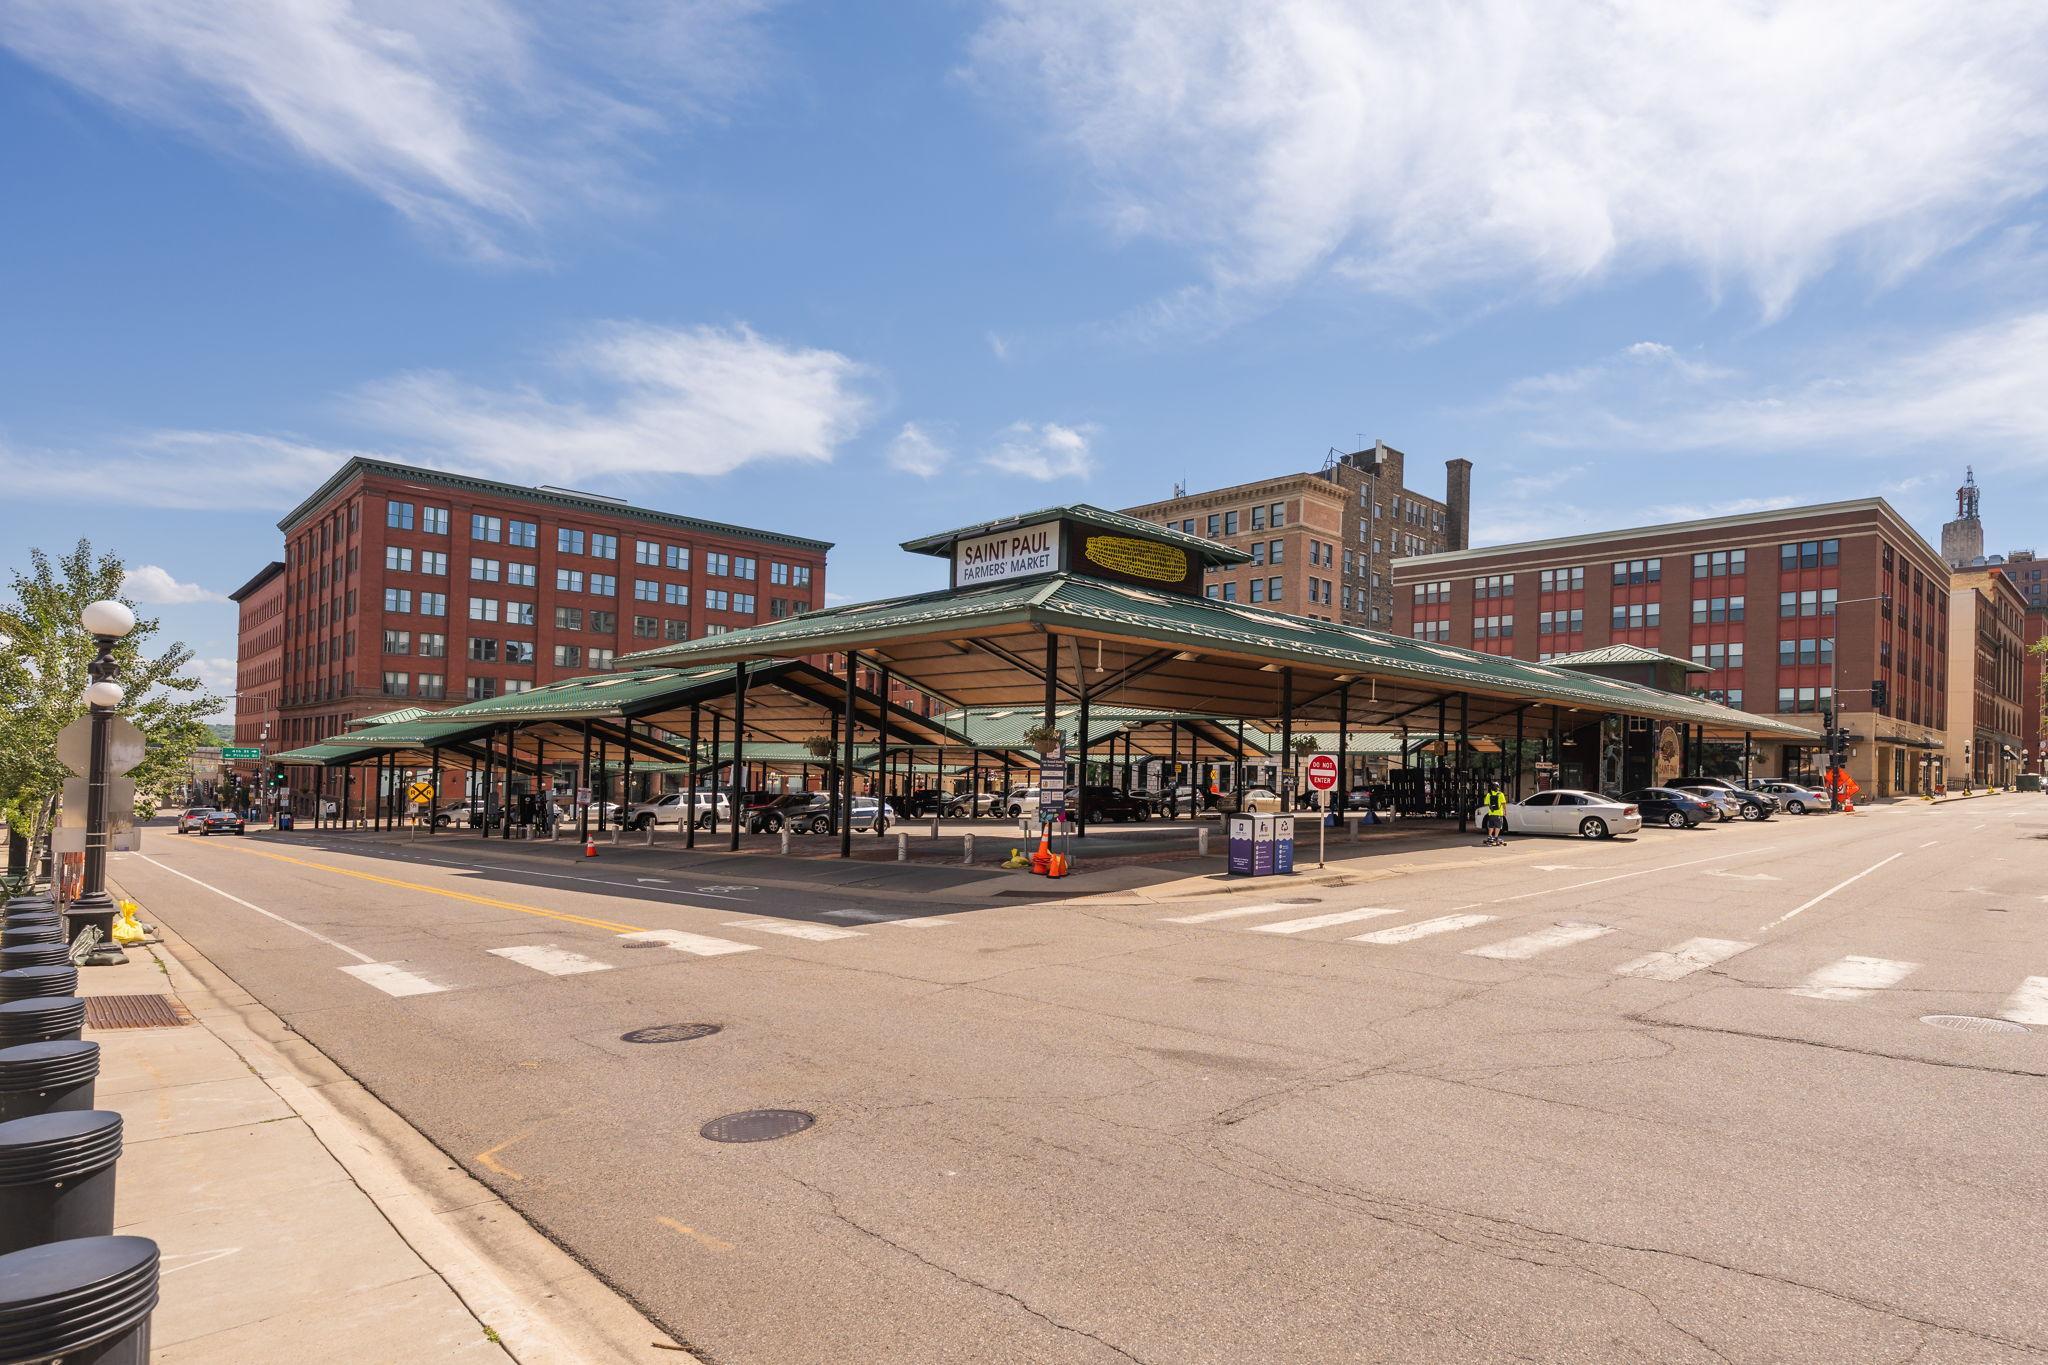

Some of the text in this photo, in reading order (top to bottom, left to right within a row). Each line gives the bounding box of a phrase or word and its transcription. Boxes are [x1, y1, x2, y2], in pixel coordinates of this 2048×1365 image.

[964, 531, 1051, 566] SAINT PAUL
[964, 554, 1050, 581] FARMERS' MARKET
